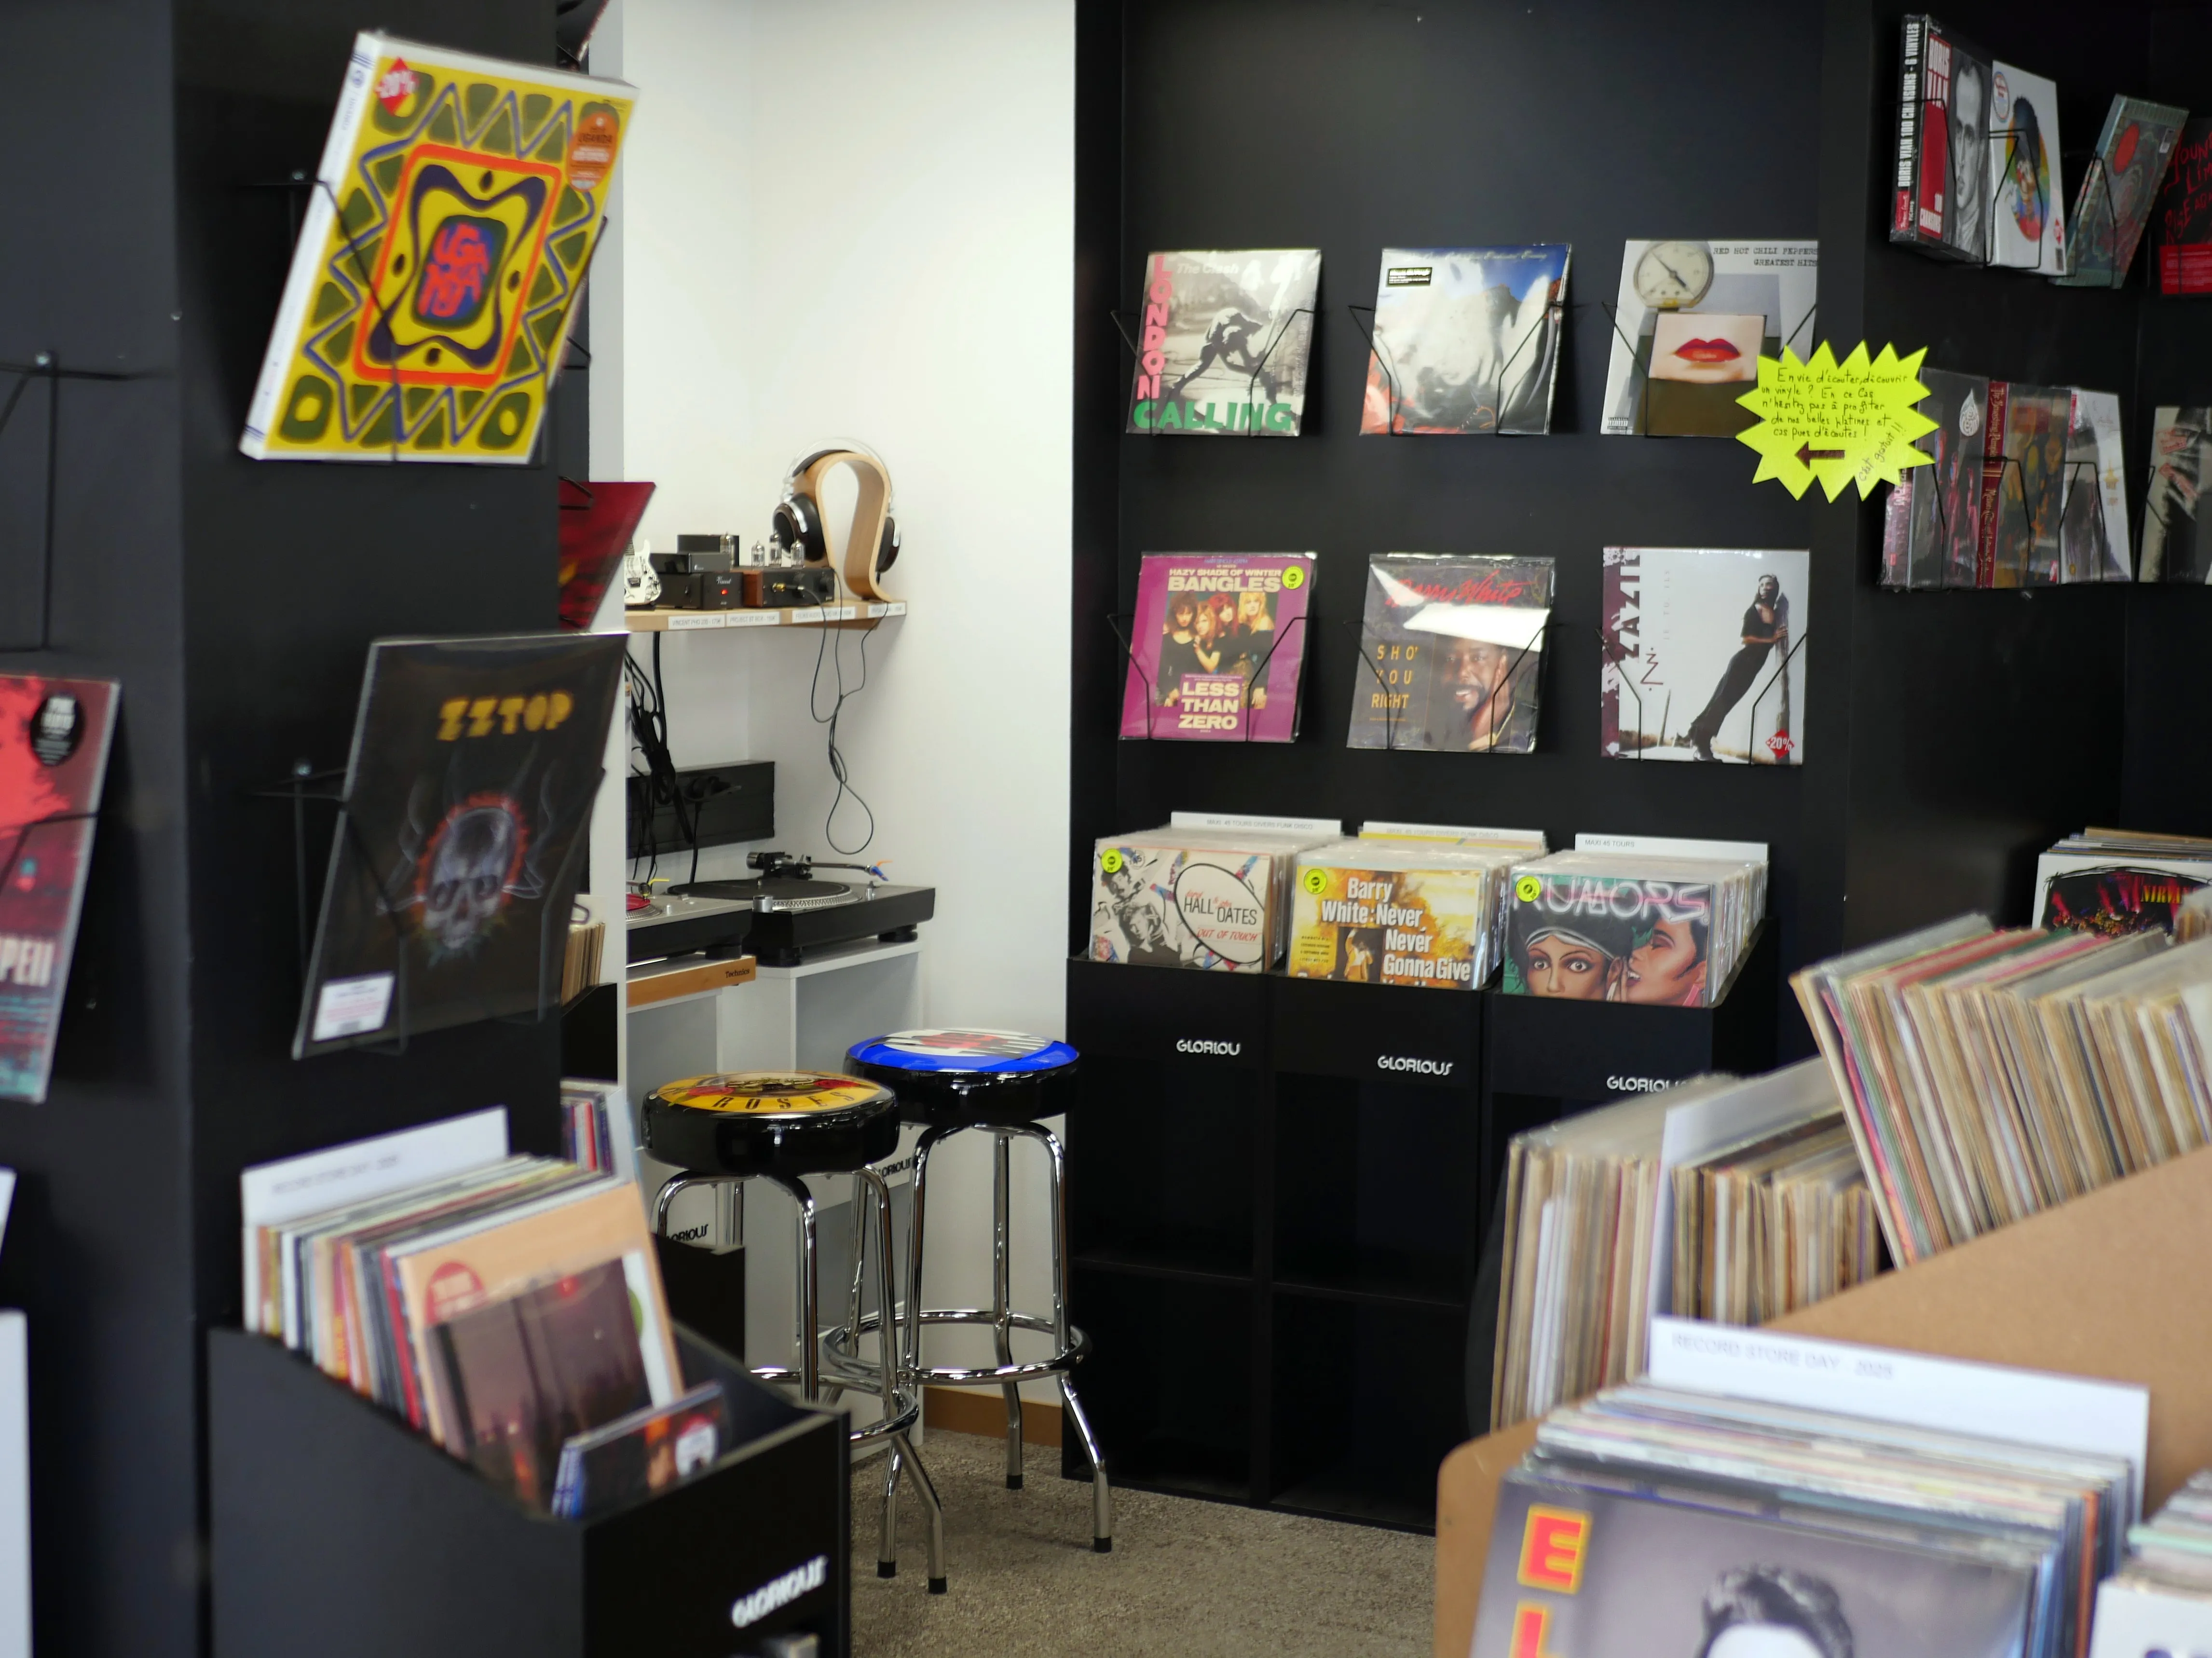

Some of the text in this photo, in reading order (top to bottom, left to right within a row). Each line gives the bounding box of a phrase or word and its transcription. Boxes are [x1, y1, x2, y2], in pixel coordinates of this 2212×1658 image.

[1905, 23, 1919, 57] VINYLES
[1902, 73, 1916, 119] CHANSONS
[1900, 121, 1914, 137] 100
[1899, 138, 1913, 160] VIAN
[1898, 161, 1912, 187] BORIS
[1177, 262, 1240, 274] The Clash
[1137, 256, 1173, 400] LONDON
[1777, 367, 1811, 382] Envie
[1775, 384, 1801, 400] vinyle
[1808, 384, 1814, 398] ?
[1822, 387, 1835, 398] En
[1133, 402, 1292, 431] CALLING
[1809, 403, 1826, 413] pas
[1771, 412, 1784, 424] de
[1807, 411, 1830, 425] belles
[1876, 413, 1891, 427] et
[1169, 568, 1196, 576] HAZY
[1197, 568, 1229, 576] SHADE
[1245, 569, 1282, 577] WINTER
[1168, 577, 1282, 593] BANGLES
[1376, 669, 1413, 685] YOU
[1182, 681, 1240, 697] LESS
[1181, 698, 1239, 713] THAN
[1371, 693, 1410, 709] RIGHT
[437, 690, 573, 741] ZZ TOP
[1178, 714, 1238, 730] ZERO
[1766, 736, 1792, 751] -20%
[1347, 877, 1393, 902] Barry
[1184, 897, 1214, 914] HALL
[1217, 907, 1257, 925] OATES
[1385, 929, 1433, 953] Never
[724, 967, 750, 978] Technics
[1383, 953, 1471, 981] Gonna Give
[1175, 1039, 1241, 1057] GLORIOU
[1376, 1055, 1454, 1076] GLORIOUS
[1606, 1075, 1686, 1093] GLORIO
[877, 1157, 913, 1178] ORIOUS
[666, 1224, 709, 1243] ORIOUS
[1672, 1331, 1741, 1358] RECORD
[1745, 1343, 1801, 1367] STORE
